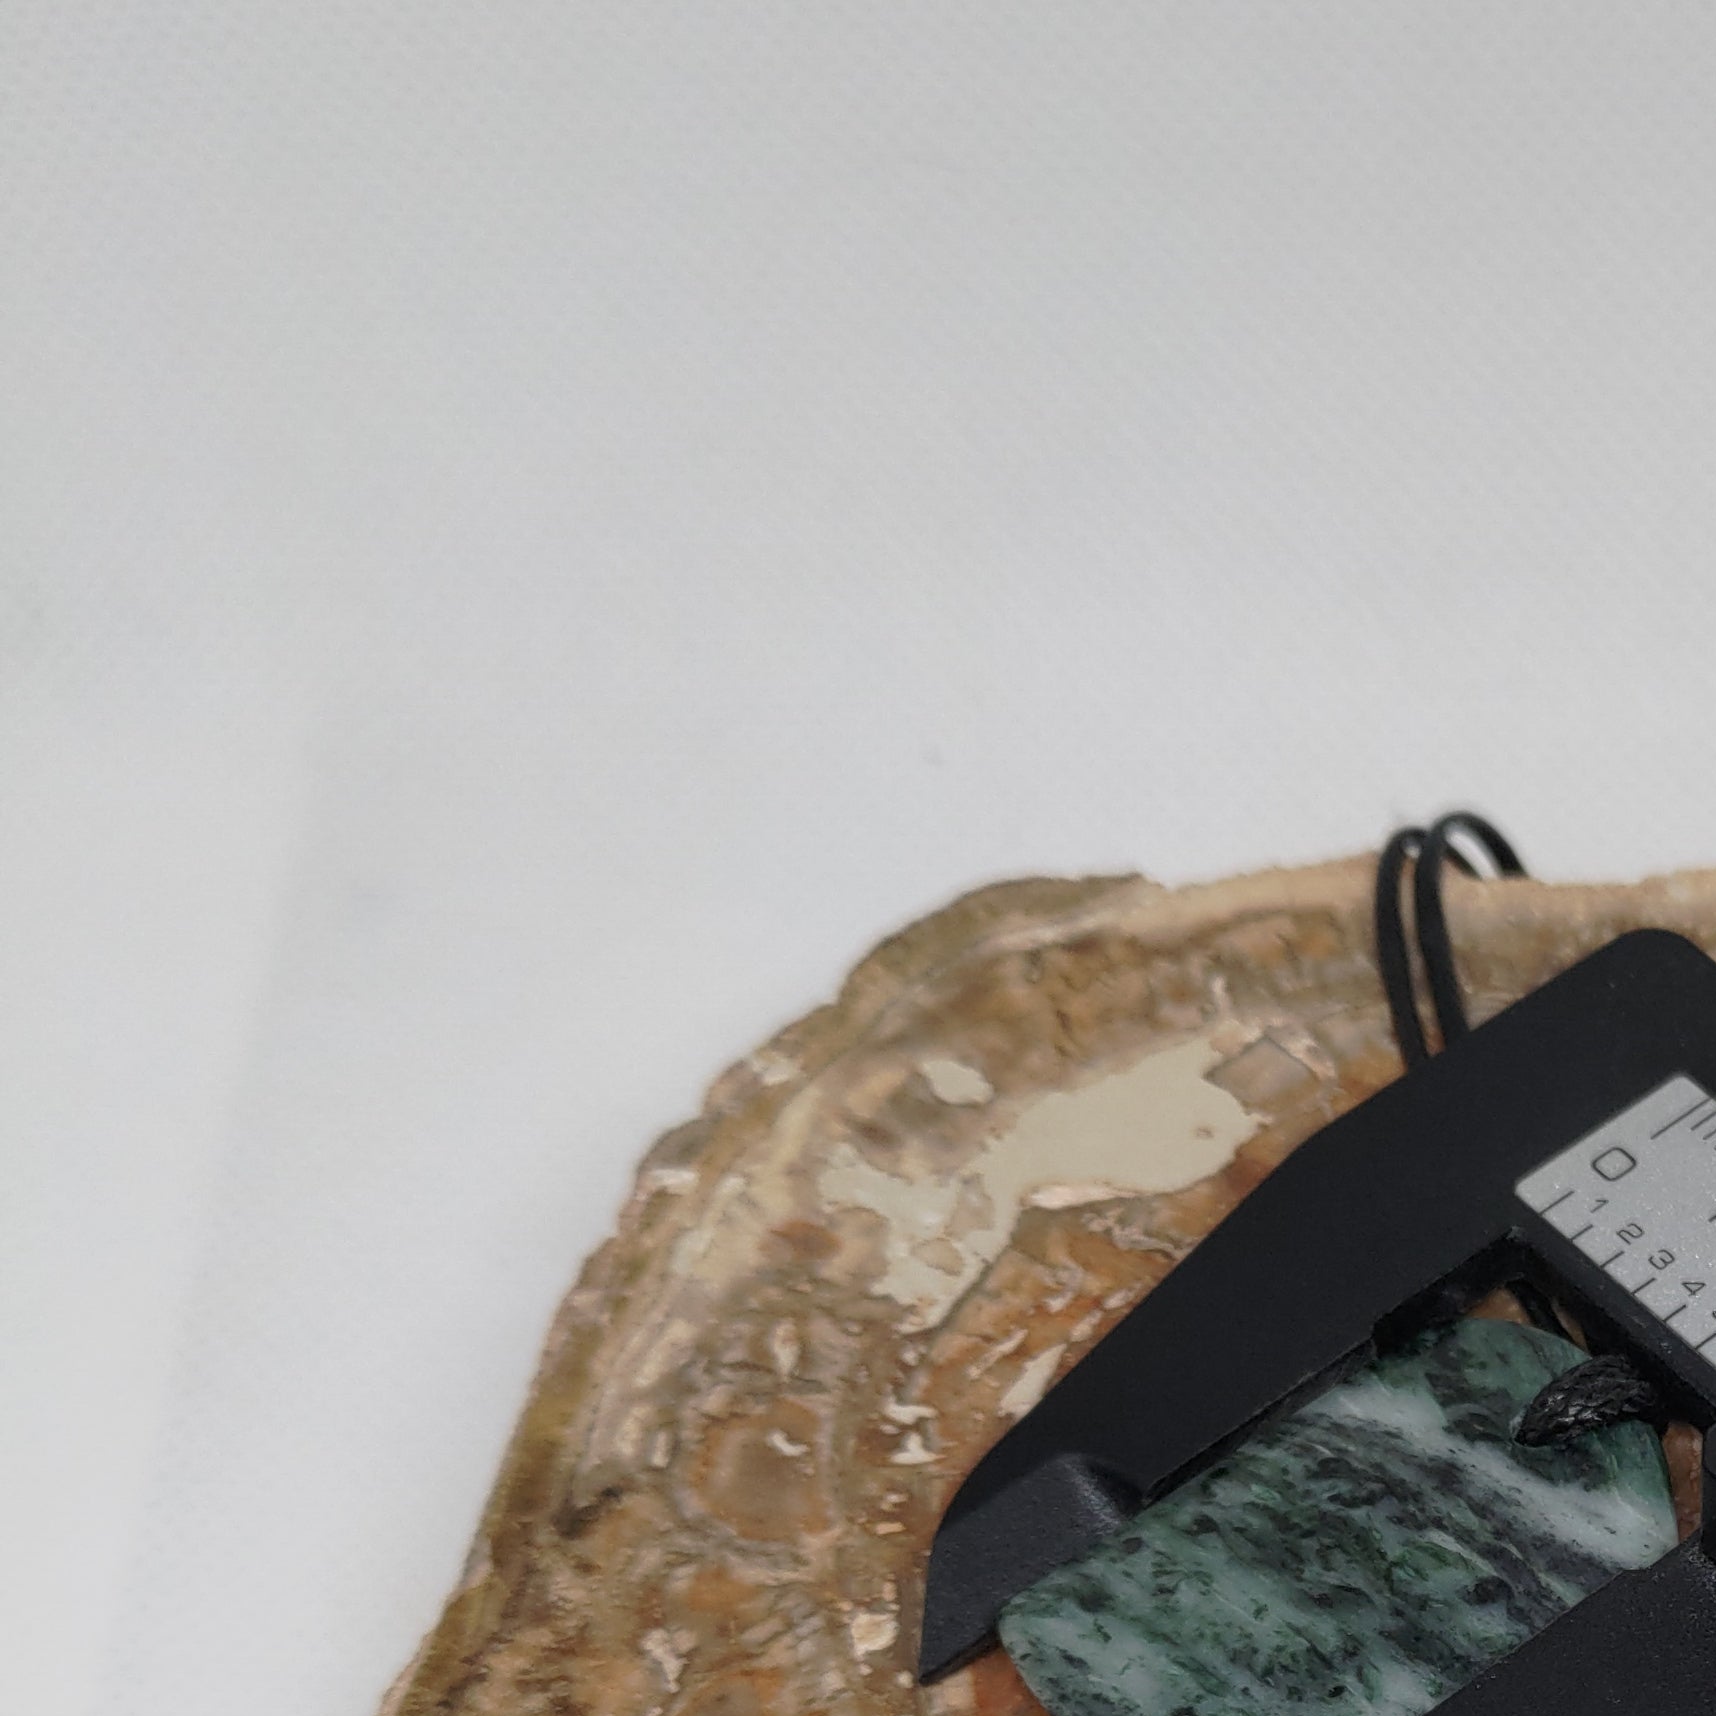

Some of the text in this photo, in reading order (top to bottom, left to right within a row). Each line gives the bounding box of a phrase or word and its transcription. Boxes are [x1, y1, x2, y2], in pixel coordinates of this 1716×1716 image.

[1590, 1146, 1637, 1181] 0
[1590, 1198, 1609, 1213] 1
[1616, 1223, 1645, 1245] 2
[1648, 1249, 1676, 1271] 3
[1681, 1279, 1707, 1296] 4
